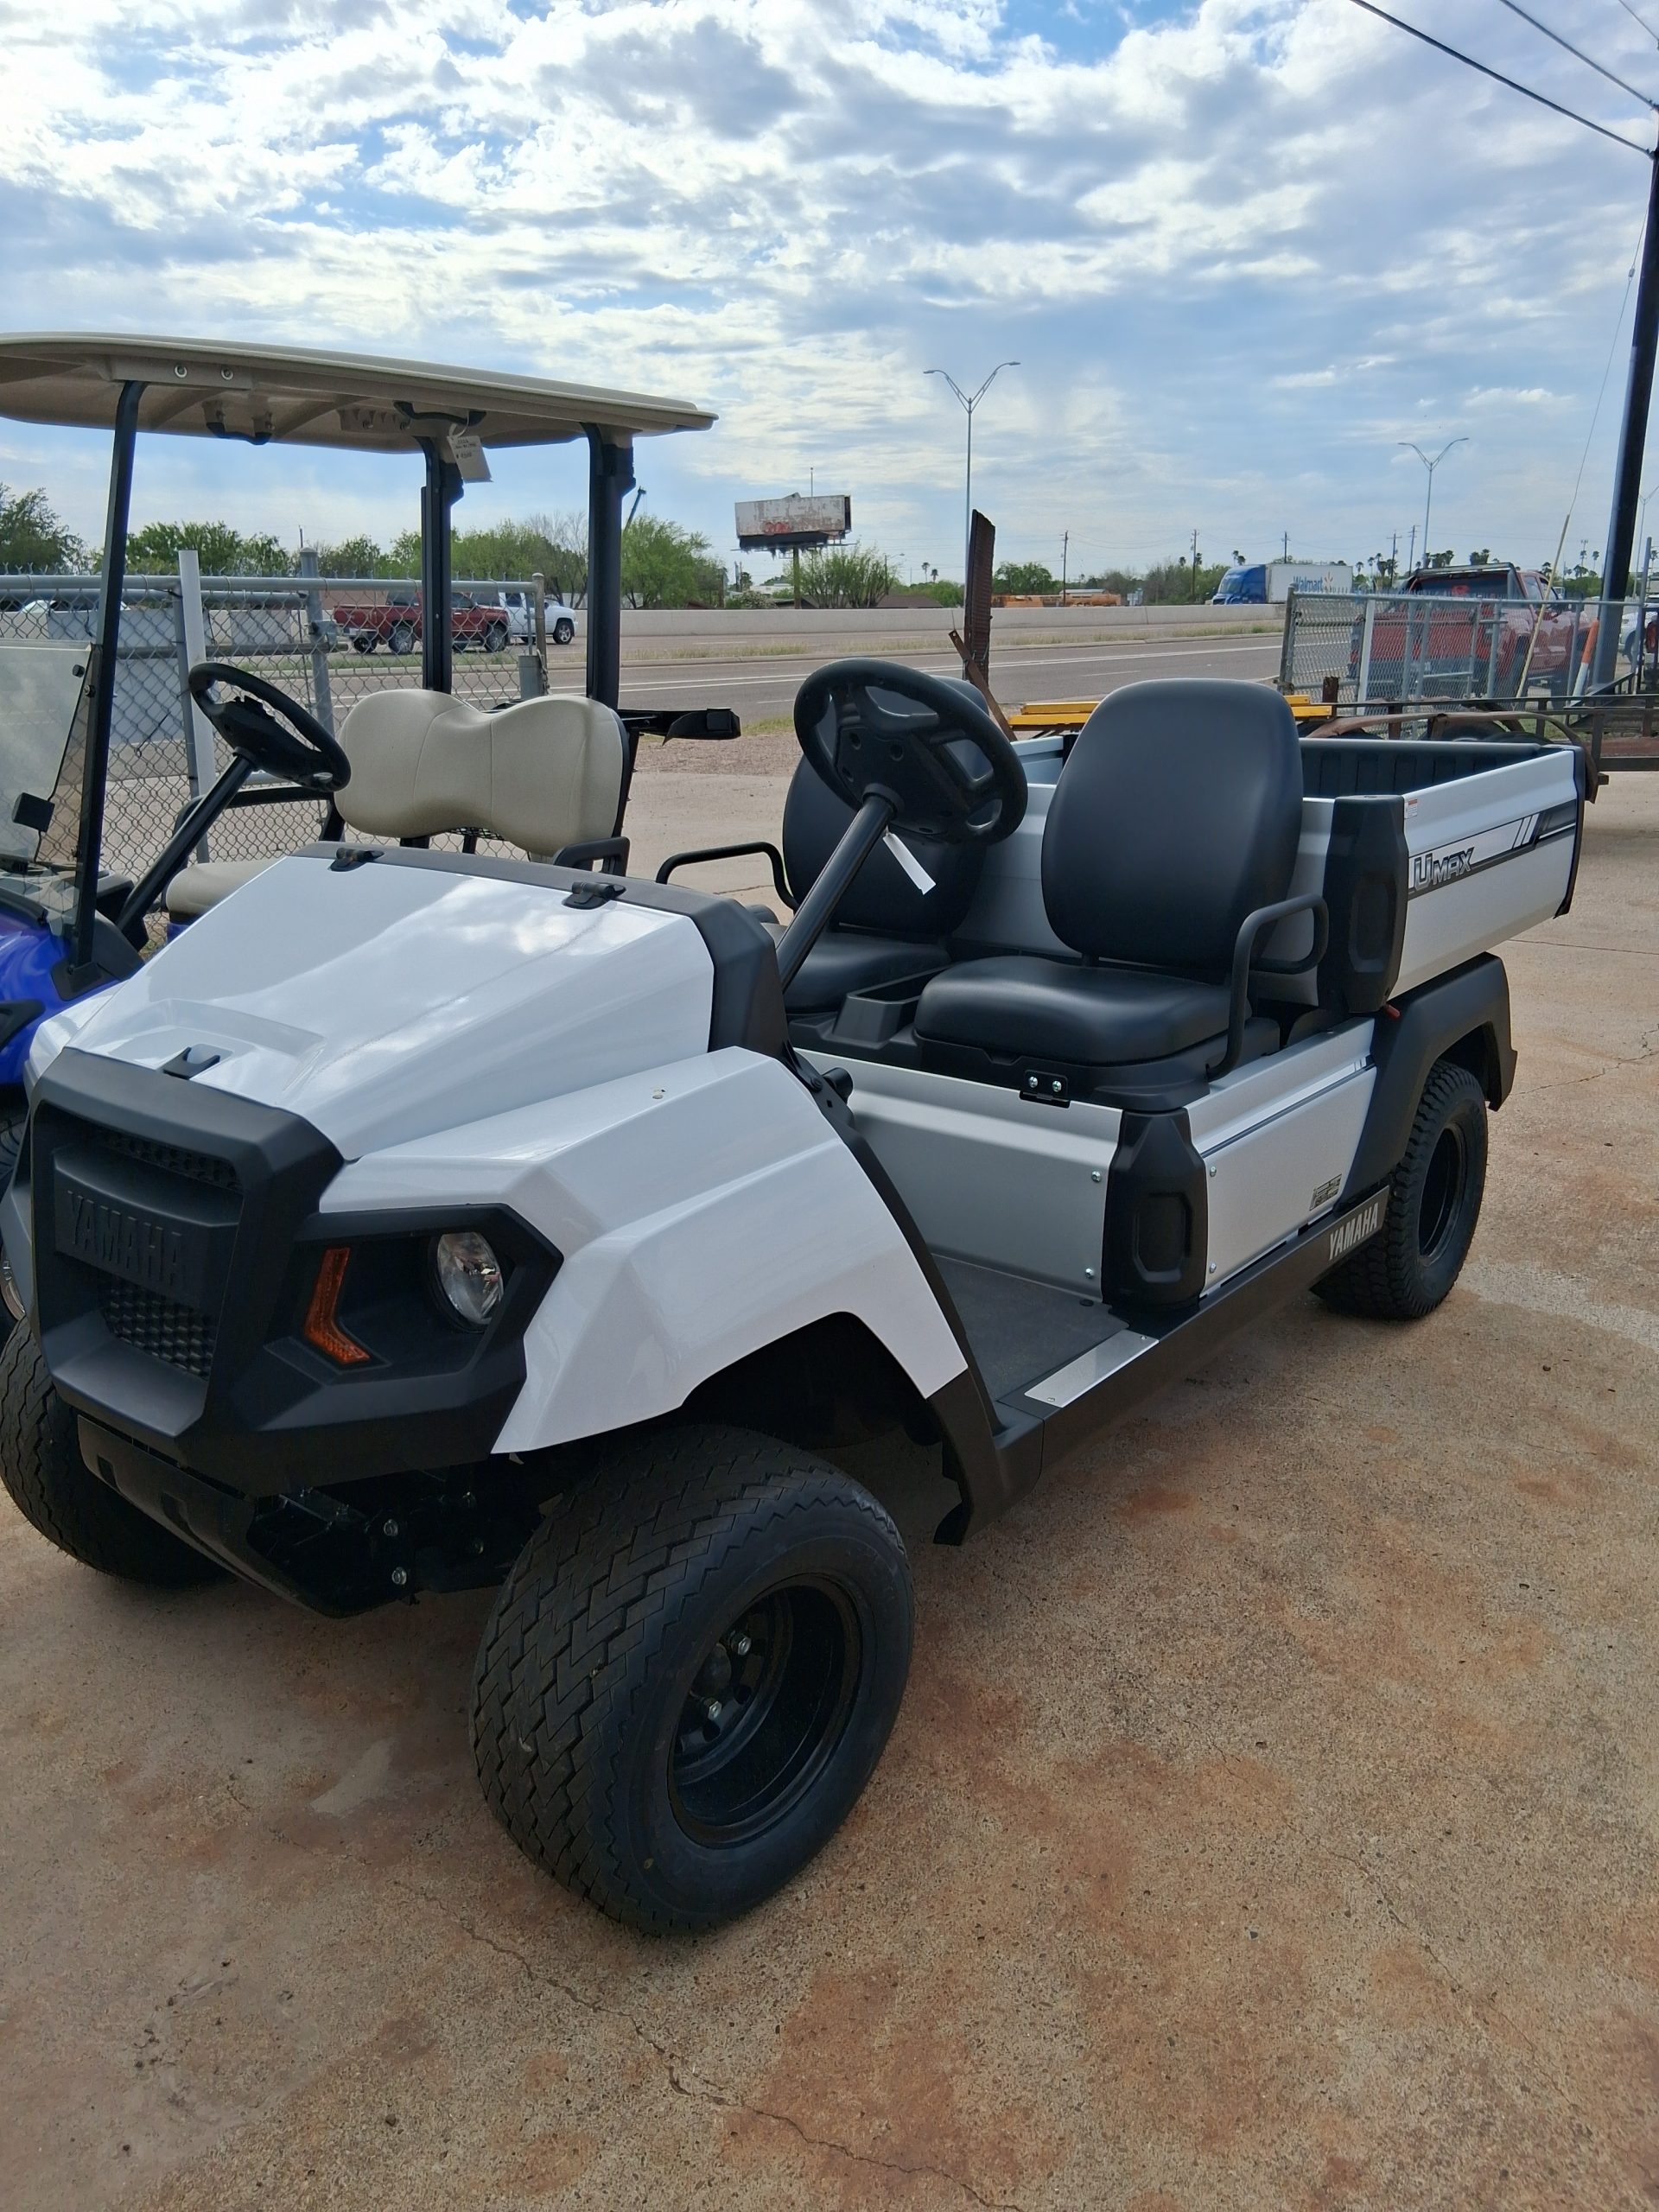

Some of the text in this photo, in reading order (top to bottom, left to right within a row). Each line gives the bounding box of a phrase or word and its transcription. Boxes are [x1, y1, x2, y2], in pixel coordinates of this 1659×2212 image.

[1294, 575, 1323, 592] Walmart
[67, 1190, 187, 1287] YAMAHA
[1329, 1202, 1379, 1261] YAMAHA
